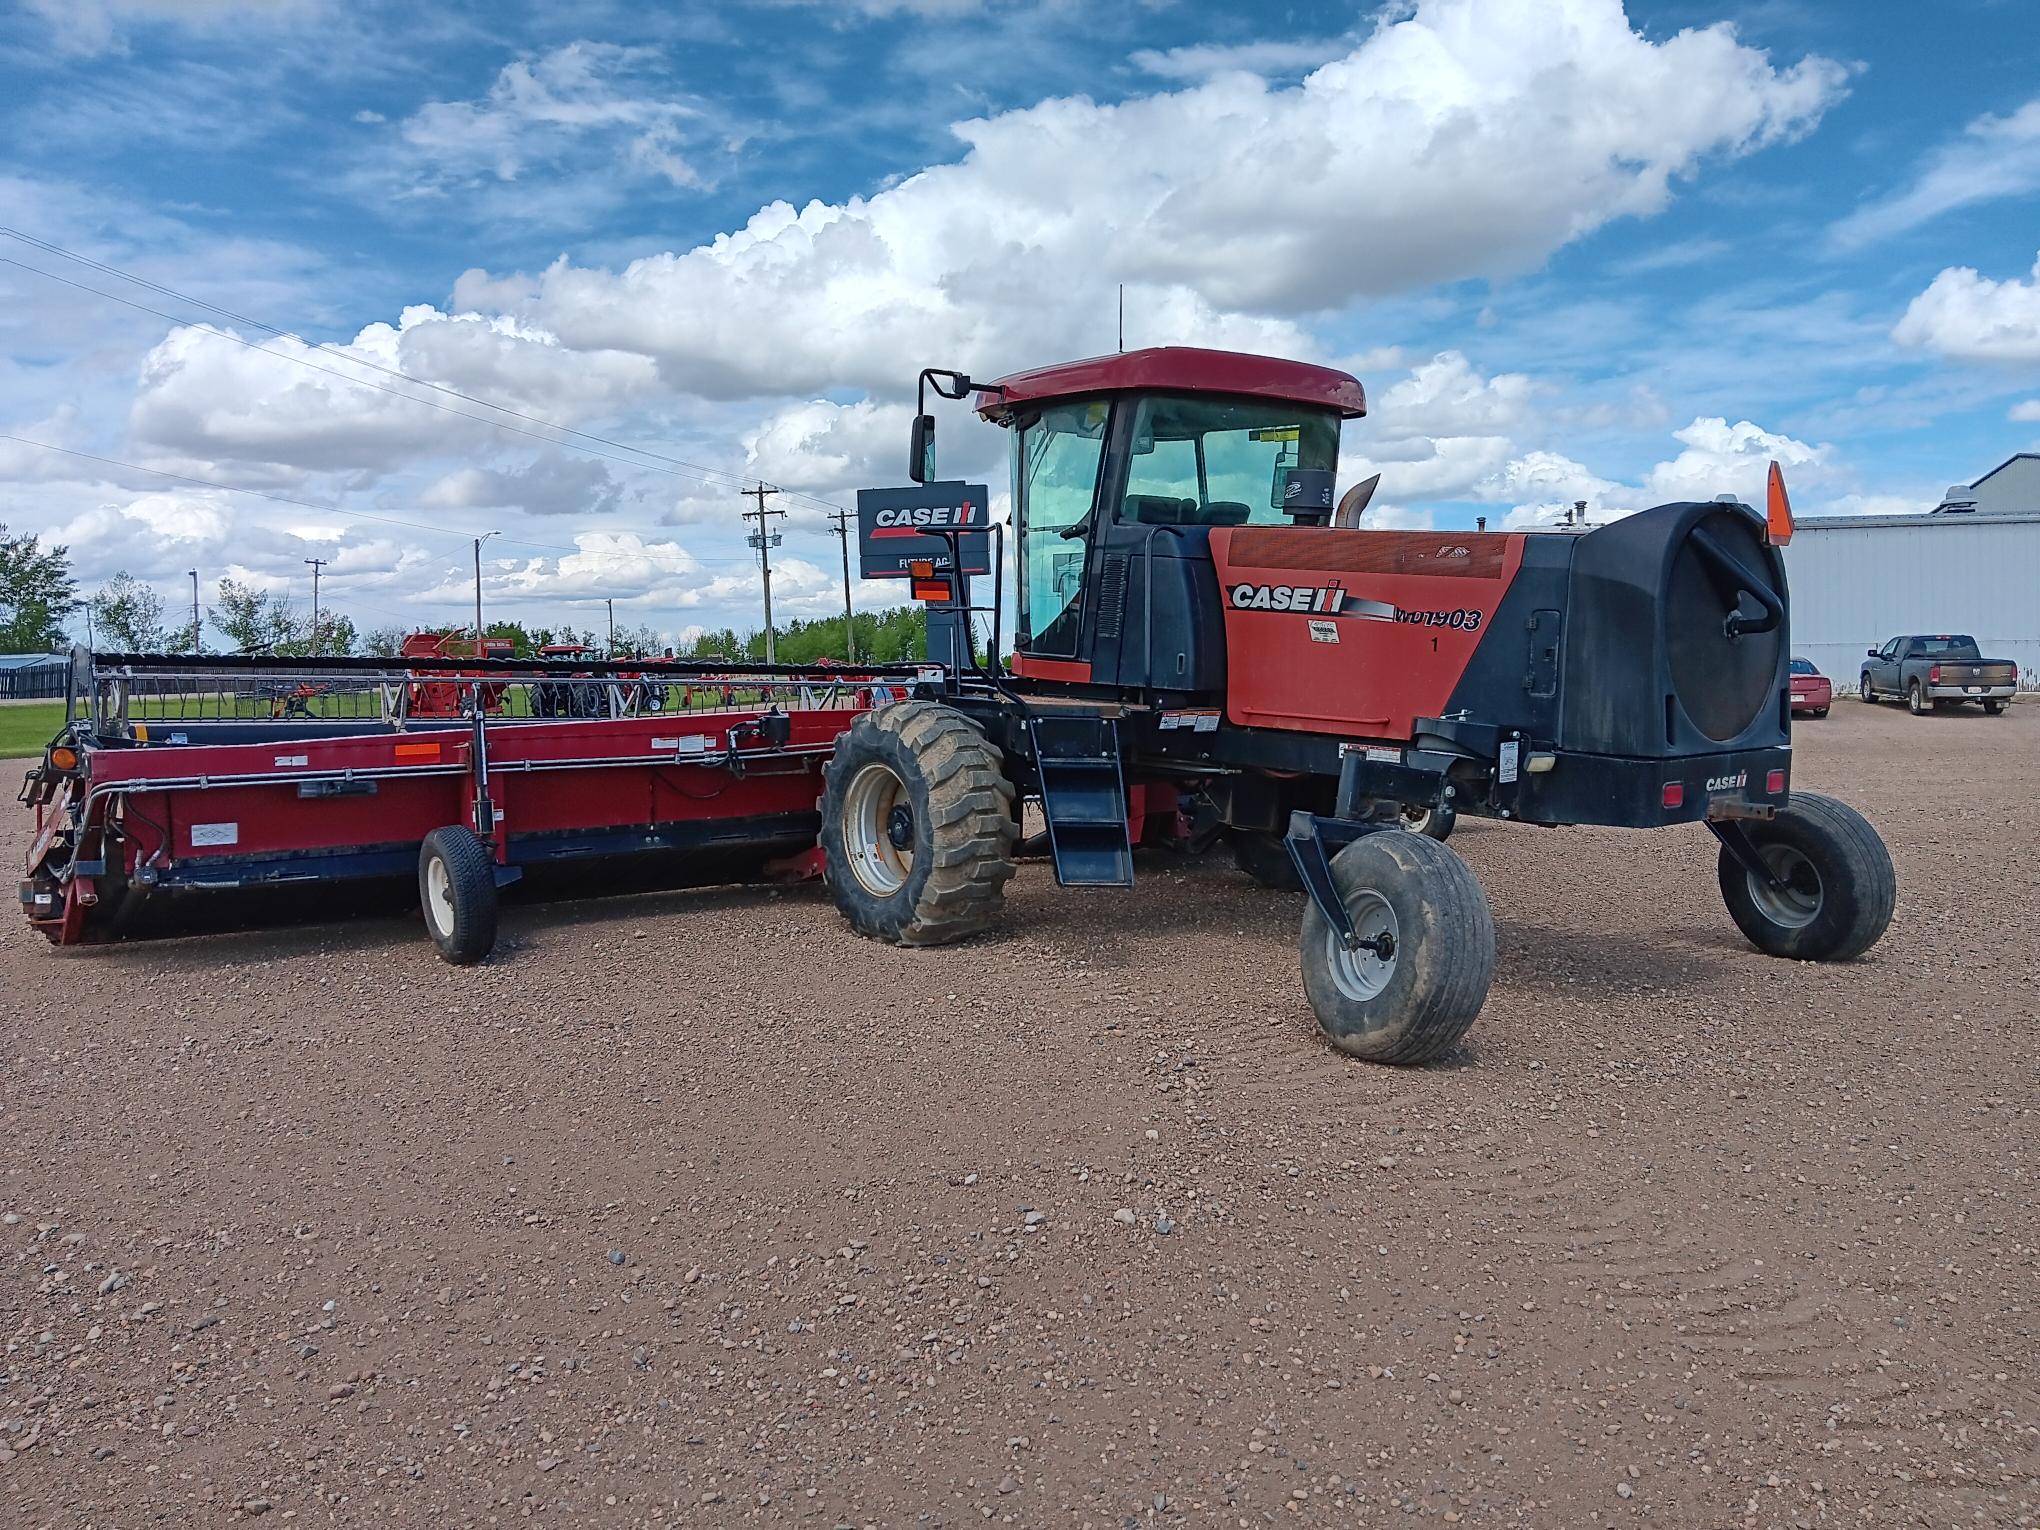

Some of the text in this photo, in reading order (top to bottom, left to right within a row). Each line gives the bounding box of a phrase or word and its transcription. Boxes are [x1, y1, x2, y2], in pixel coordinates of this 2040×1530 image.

[876, 507, 949, 527] CASE
[1232, 584, 1313, 611] CASE
[1395, 607, 1483, 632] WD1903
[1431, 636, 1438, 652] 1
[1705, 774, 1736, 792] CASE
